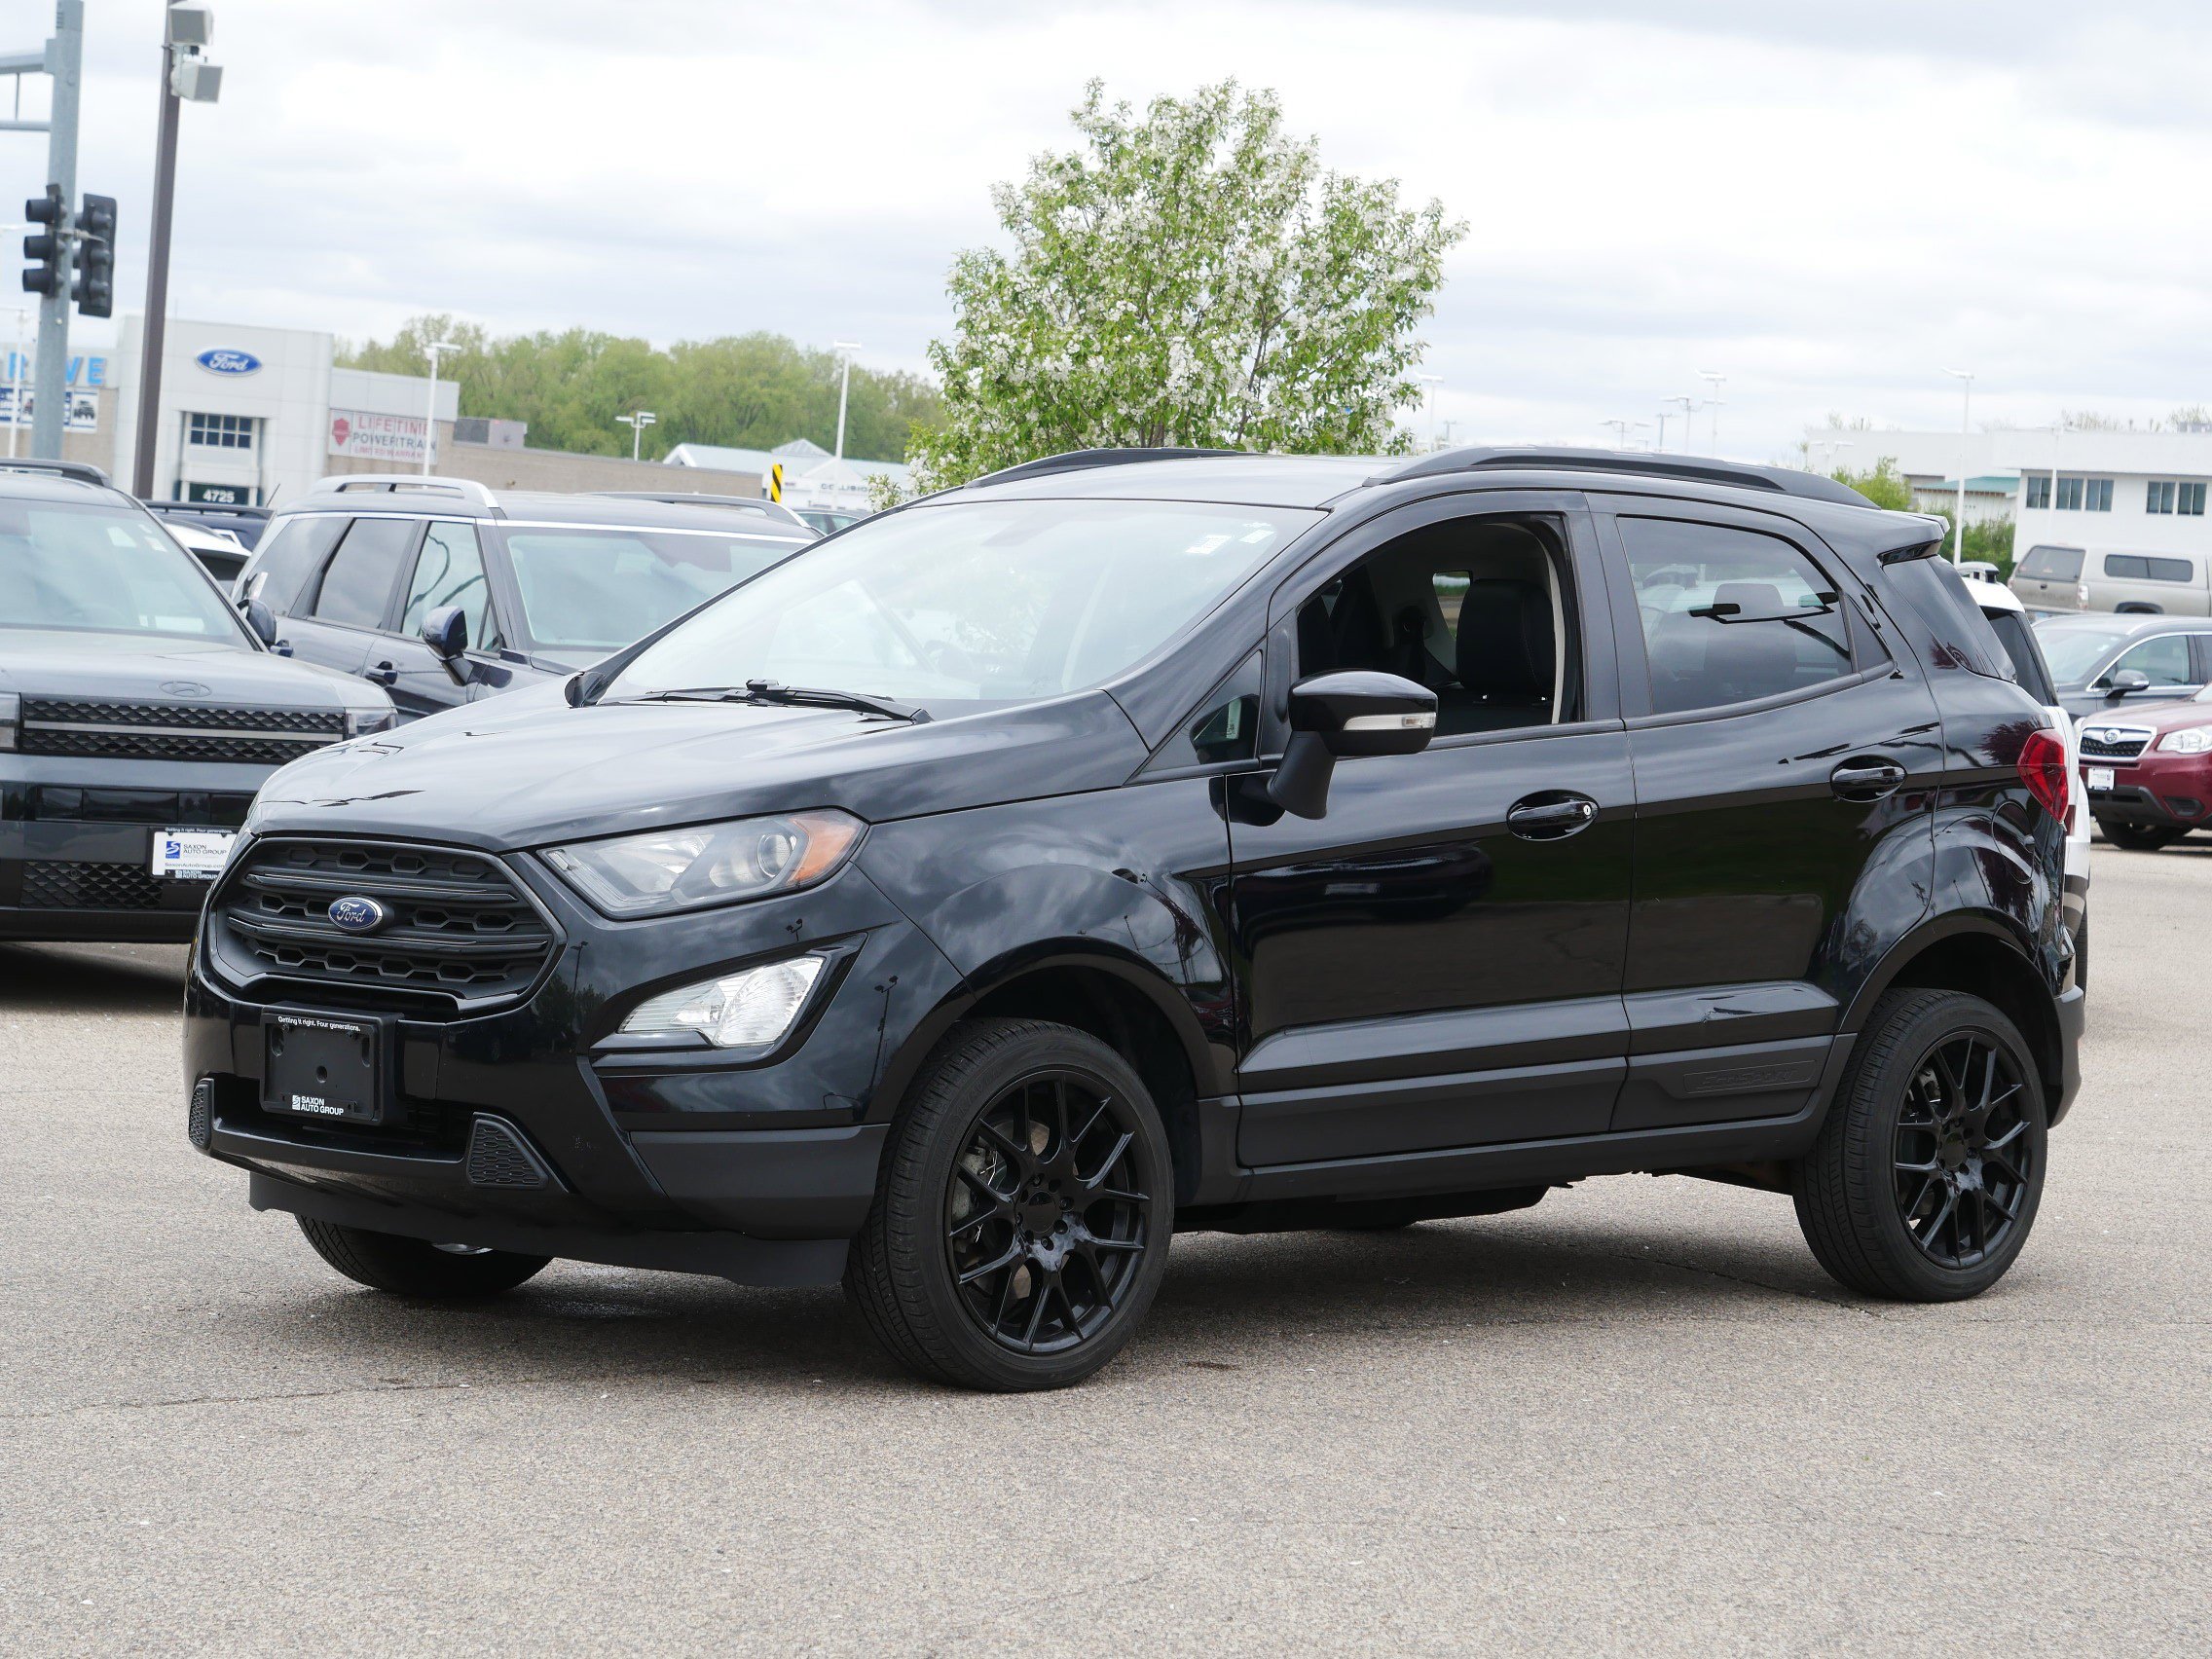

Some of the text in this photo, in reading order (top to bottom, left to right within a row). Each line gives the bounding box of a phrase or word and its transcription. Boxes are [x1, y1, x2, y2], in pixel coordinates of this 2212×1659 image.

[352, 432, 437, 450] POWERTRAN
[203, 489, 235, 503] 4725
[277, 1015, 298, 1025] Getting
[302, 1018, 316, 1027] right.
[329, 1022, 361, 1032] generations.
[301, 1096, 325, 1106] SAXON
[320, 1106, 344, 1116] GROUP
